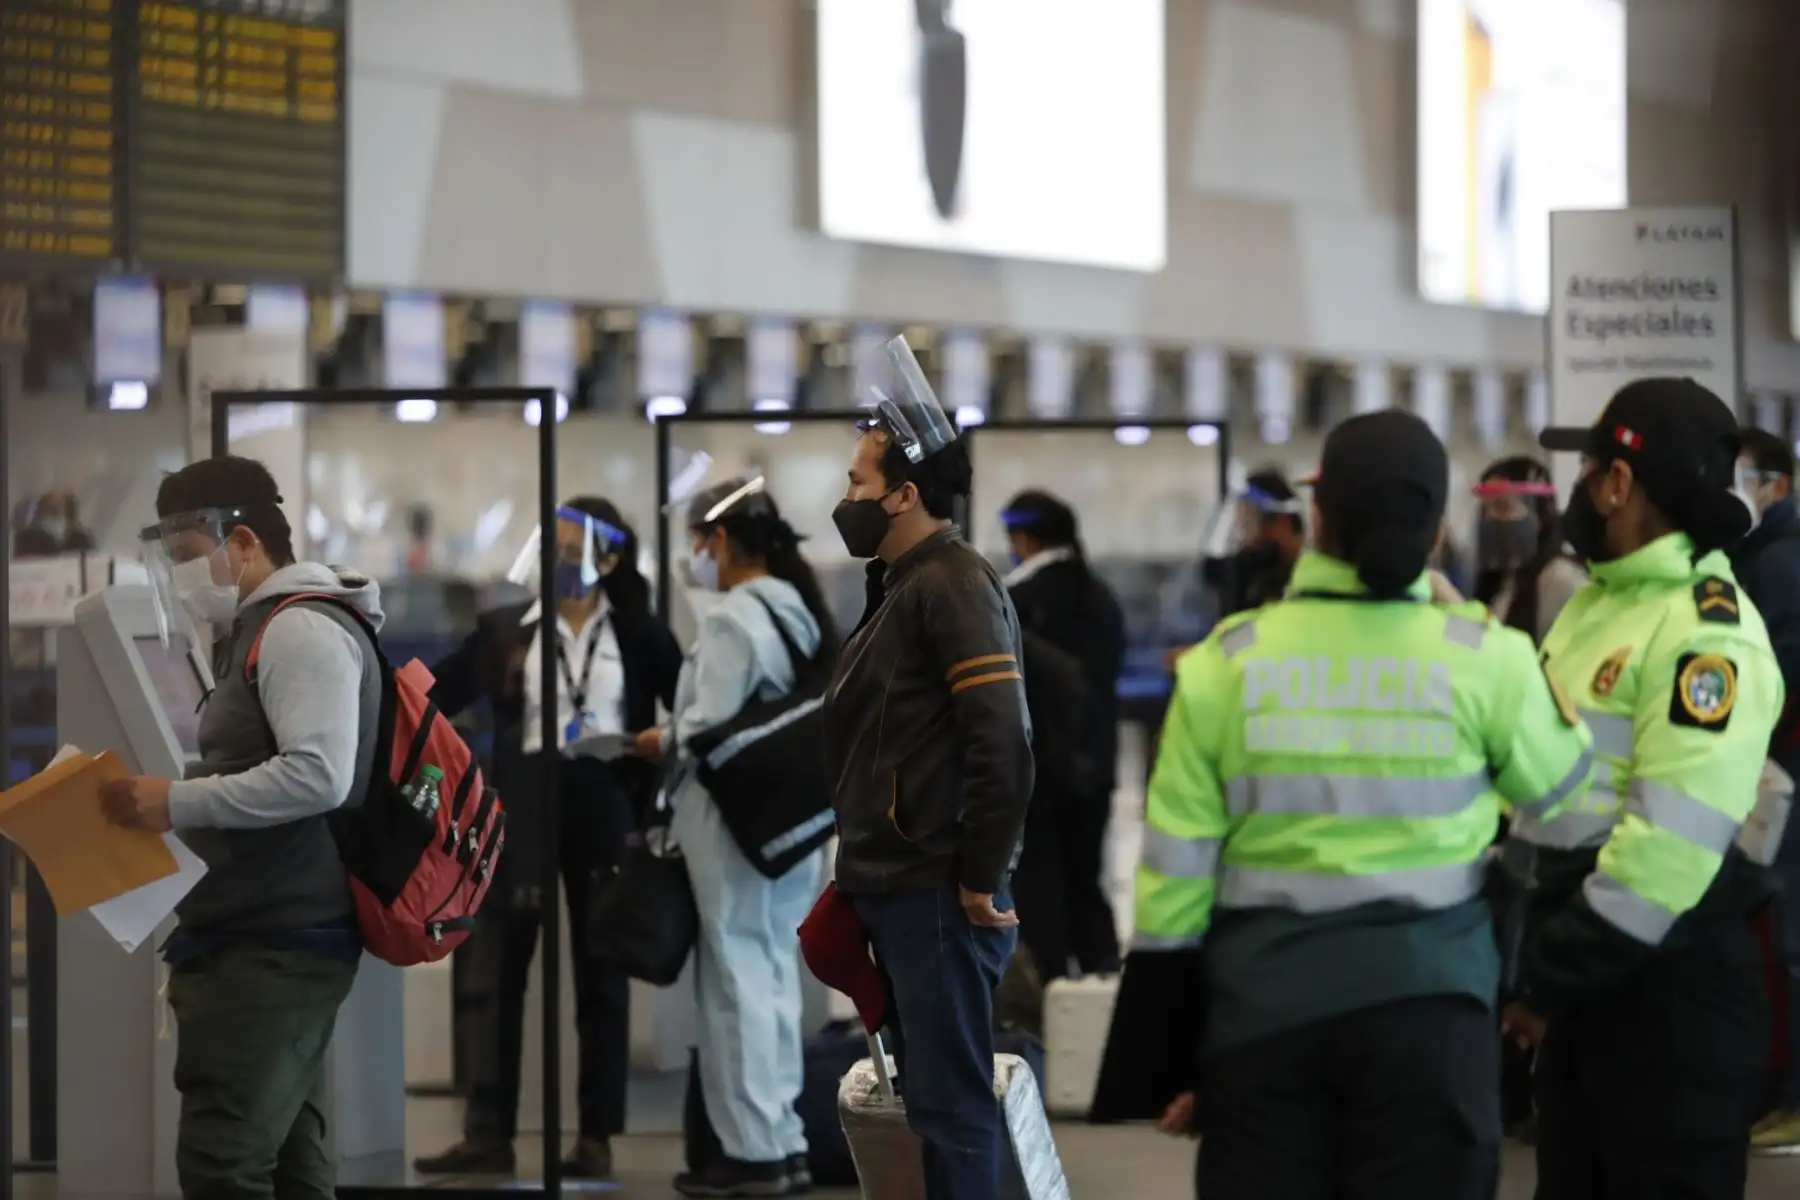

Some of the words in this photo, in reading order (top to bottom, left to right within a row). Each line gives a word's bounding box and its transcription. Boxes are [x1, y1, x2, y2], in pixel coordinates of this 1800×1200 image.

[1567, 273, 1718, 302] Atenciones
[1567, 307, 1715, 343] Especiales
[1243, 656, 1454, 716] POLICIA
